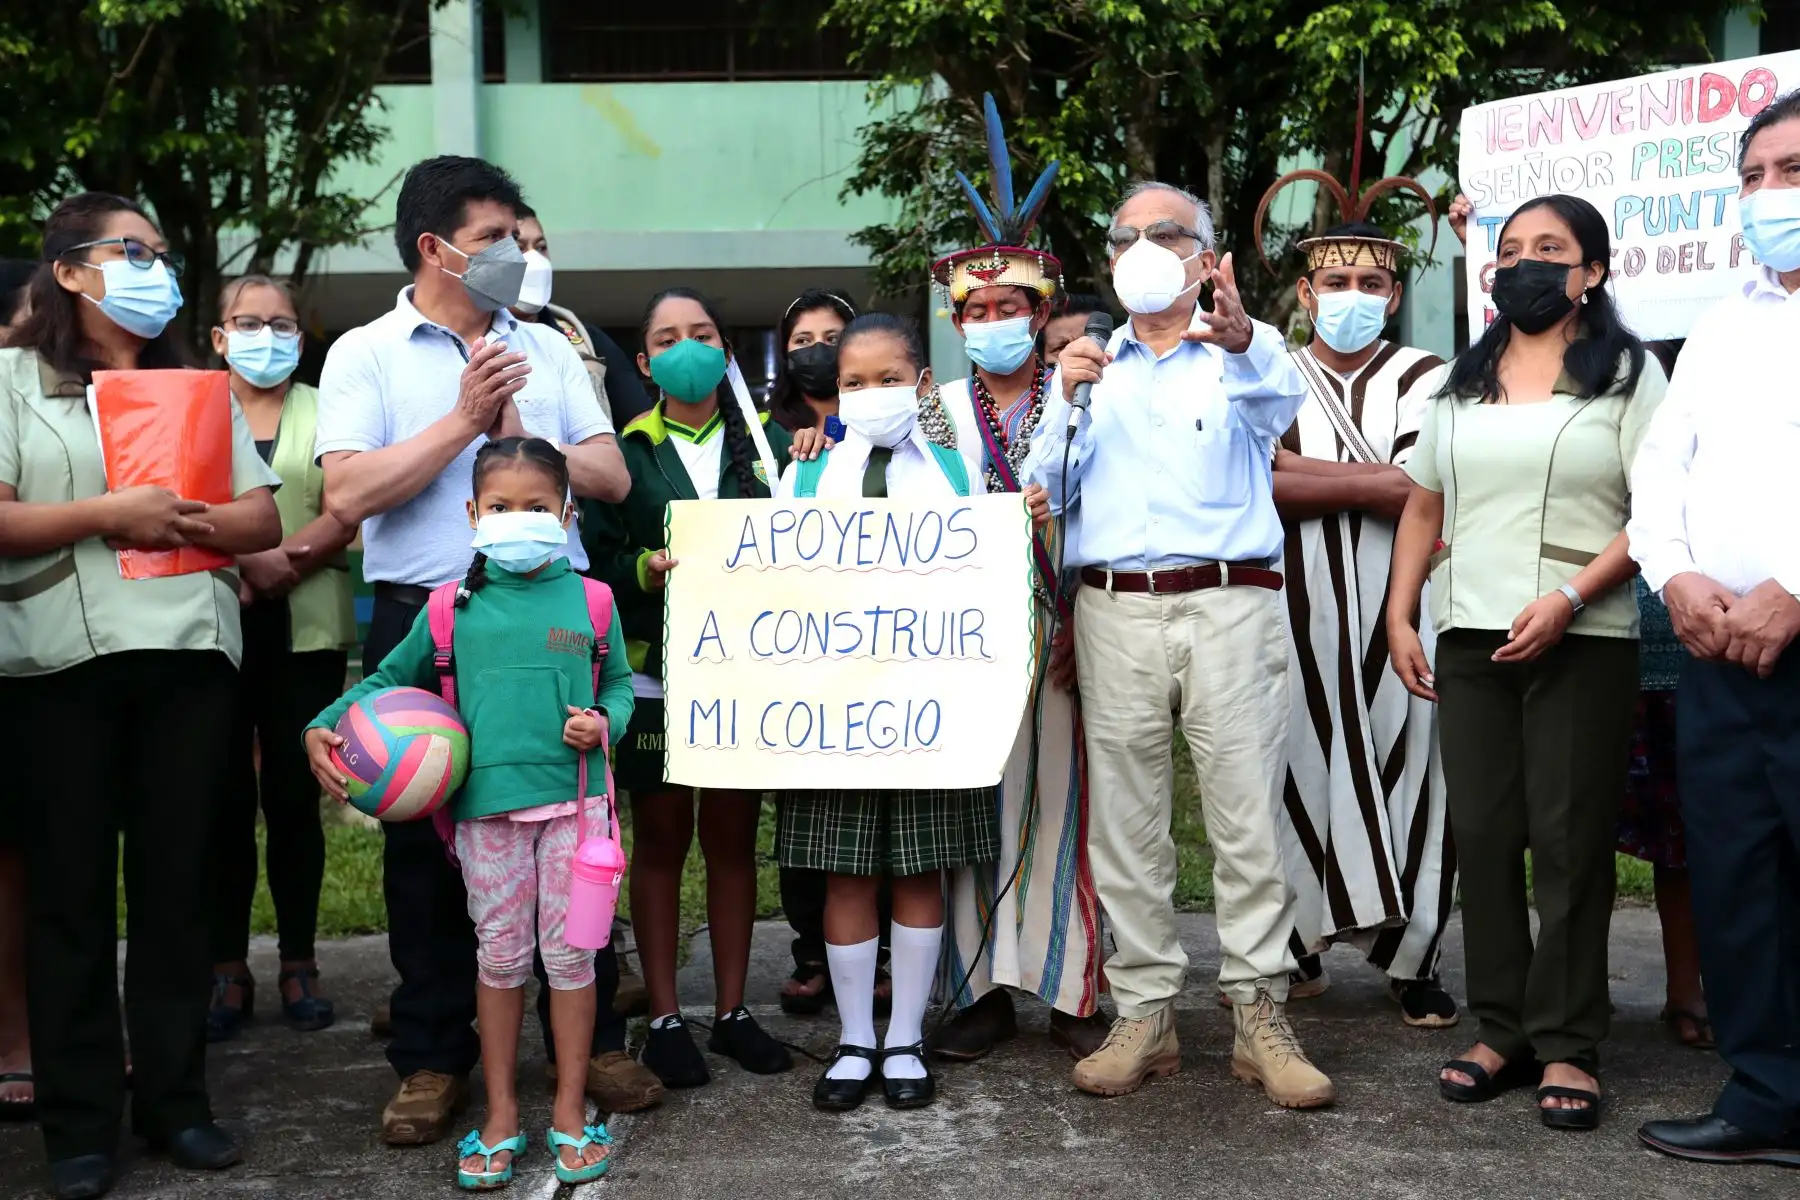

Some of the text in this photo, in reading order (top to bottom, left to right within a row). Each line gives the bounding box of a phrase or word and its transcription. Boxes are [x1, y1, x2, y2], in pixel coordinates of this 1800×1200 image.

[1472, 66, 1778, 156] IENVENIDO
[1468, 151, 1614, 209] SEÑOR
[1656, 241, 1715, 275] DEL
[726, 507, 978, 568] APOYENOS
[693, 605, 992, 659] A CONSTRUIR
[689, 698, 942, 751] MI COLEGIO
